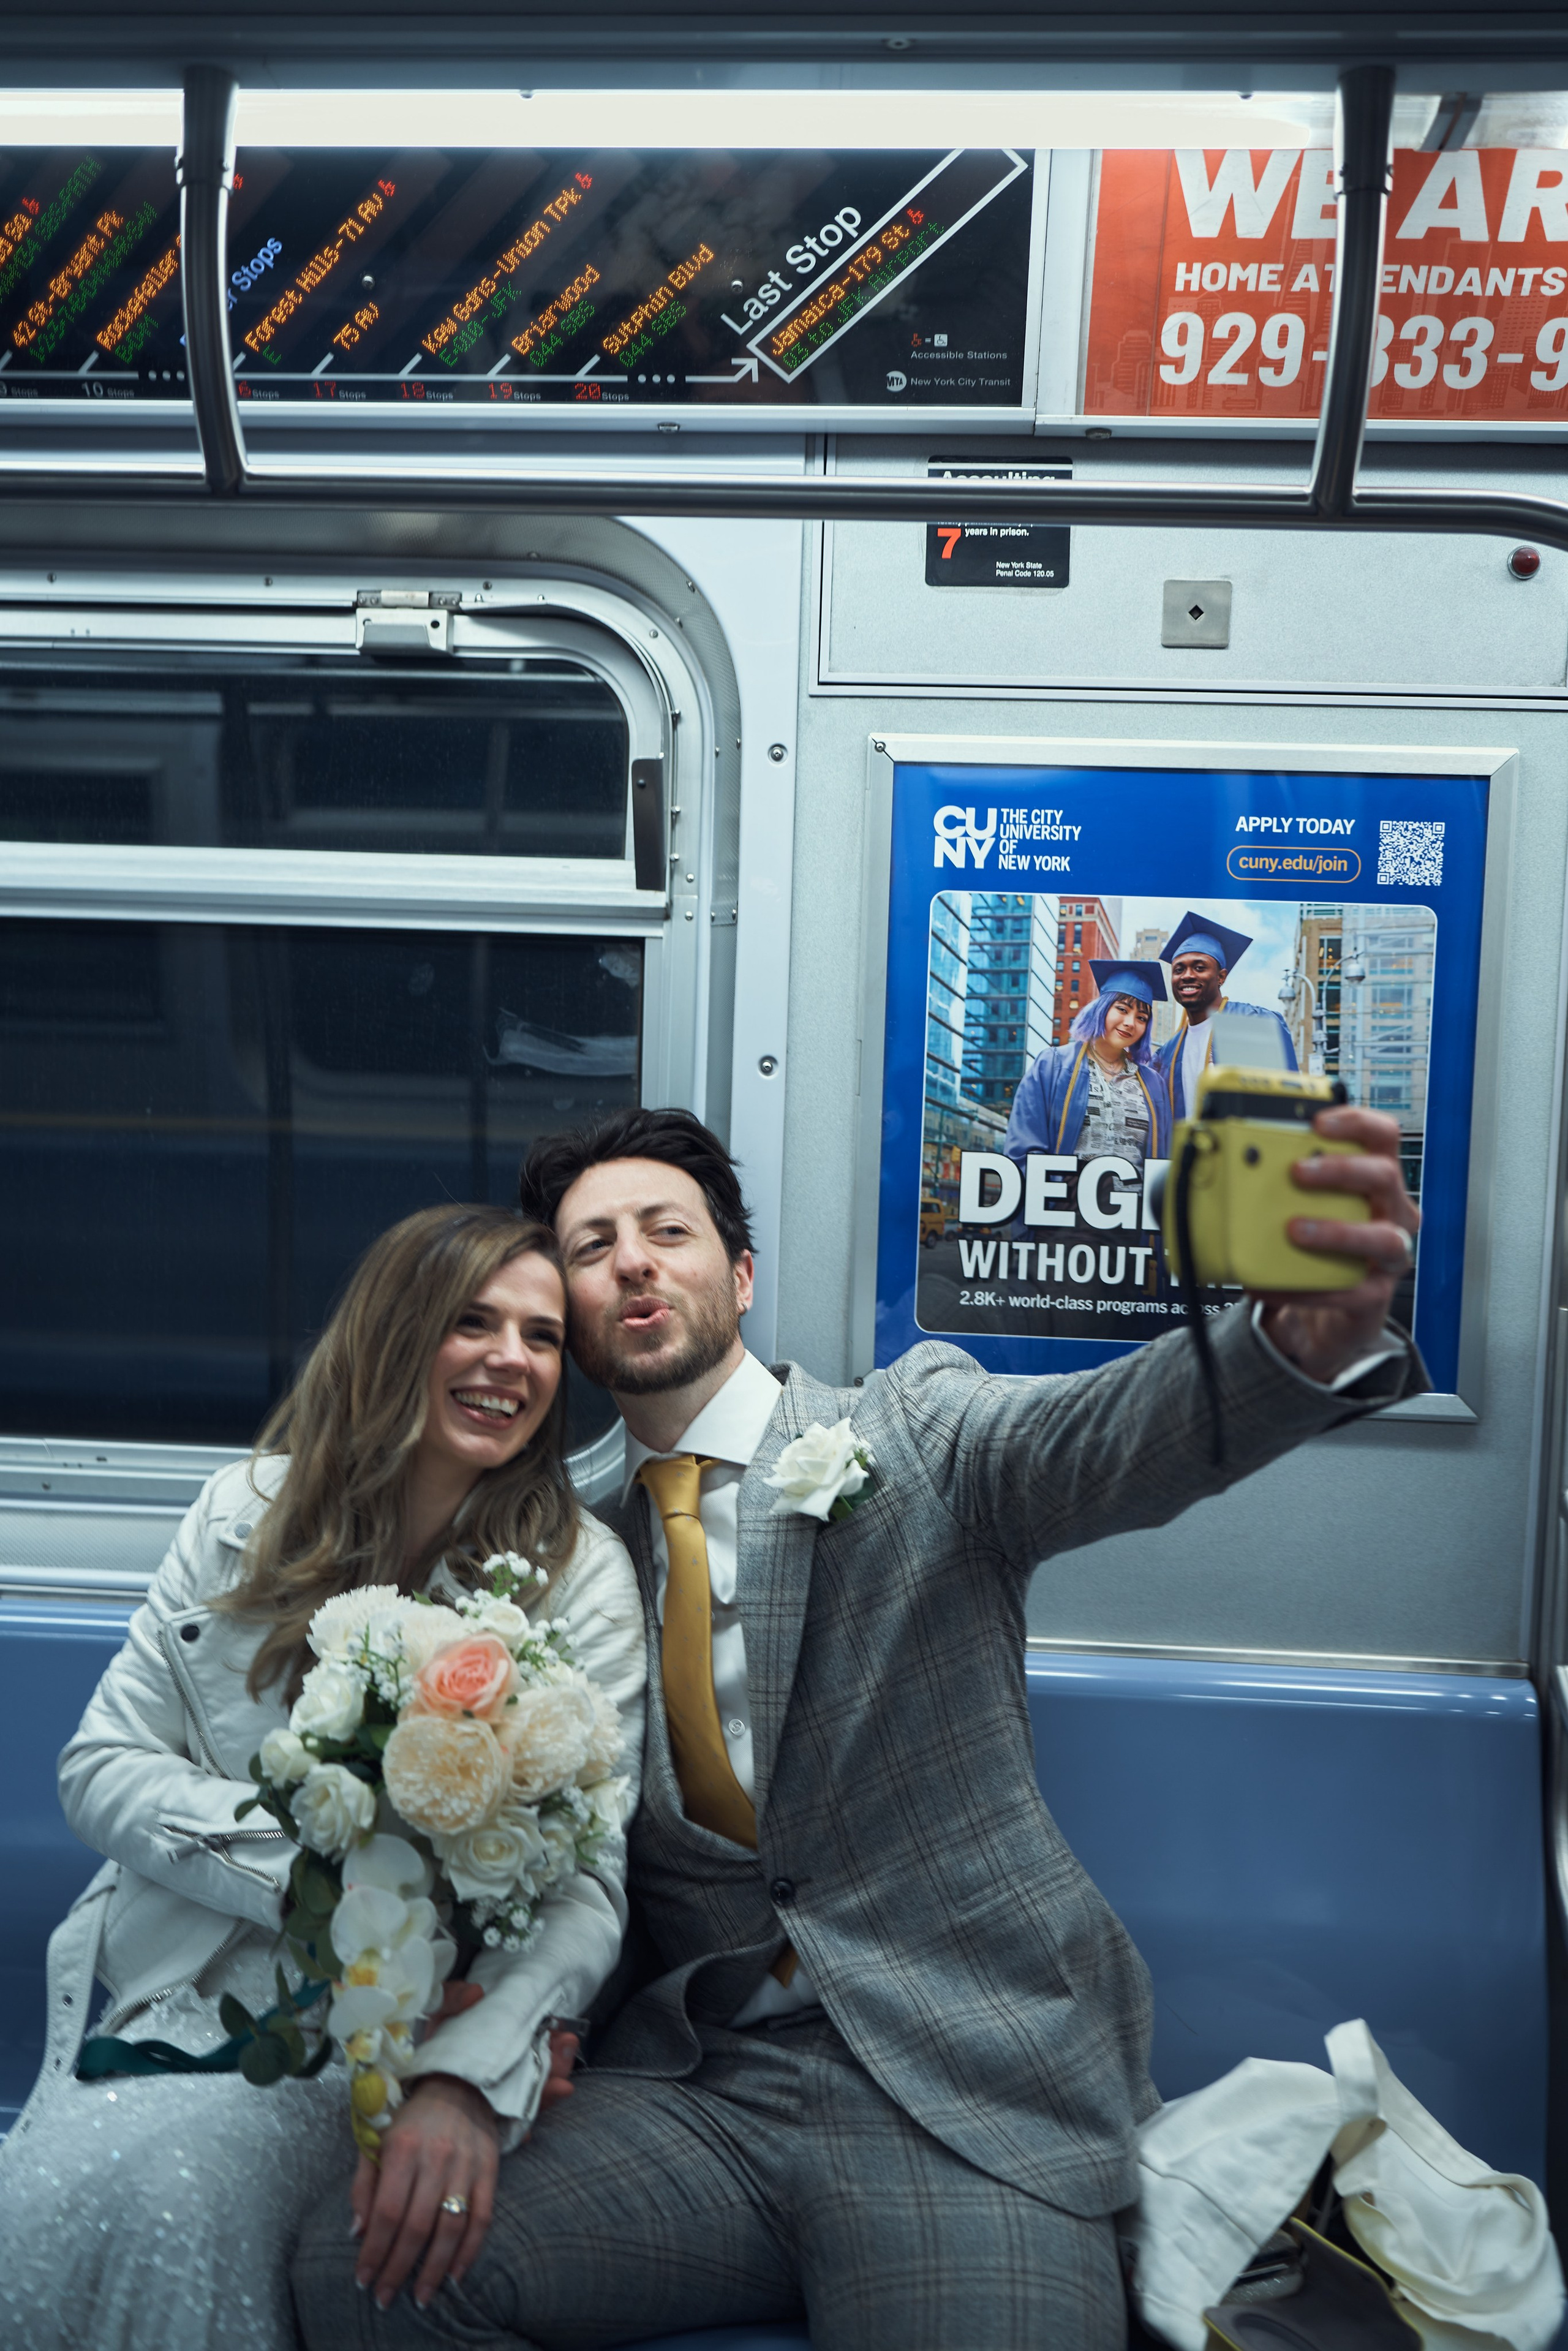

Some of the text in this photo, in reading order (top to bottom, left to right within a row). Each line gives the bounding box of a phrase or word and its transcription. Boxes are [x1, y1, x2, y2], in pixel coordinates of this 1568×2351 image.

[1174, 149, 1336, 240] WE
[232, 237, 283, 292] Stops
[245, 193, 383, 352] Forest Hills-71 Av
[422, 188, 582, 354] Kew Gdns-Union Tpk
[720, 206, 862, 335] Last Stop
[13, 211, 123, 348] 42 St-Bryant Pk
[772, 225, 910, 355] Jamaica-179 St
[1175, 263, 1567, 296] HOME AENDANTS
[96, 250, 179, 351] Rockefeller
[603, 244, 714, 354] Sutphin Blvd
[783, 222, 944, 369] Q3 to JFK Airport
[512, 265, 600, 355] Briarwood
[333, 303, 379, 350] 75 Av
[530, 301, 595, 366] Q44 SBS
[619, 301, 686, 366] Q44 SBS
[263, 345, 281, 364] E
[911, 351, 1008, 360] Accessible Stations
[81, 382, 135, 399] 10 Stops
[252, 389, 280, 401] Stops
[314, 381, 366, 401] 17 Stops
[426, 390, 454, 402] Stops
[489, 382, 541, 402] 19 Stops
[575, 383, 630, 402] 20 Stops
[934, 377, 955, 386] York
[958, 377, 976, 387] City
[979, 377, 1011, 386] Transit
[937, 528, 962, 559] 7
[965, 527, 1030, 538] years in prison.
[1001, 808, 1063, 825] THE CITY
[1235, 816, 1355, 834] APPLY TODAY
[1000, 823, 1082, 841] UNIVERSITY
[999, 839, 1018, 855] OF
[998, 855, 1070, 872] NEW YORK
[1238, 855, 1348, 874] cuny.edu/join
[959, 1239, 1153, 1286] WITHOUT
[959, 1290, 1221, 1316] 2.8K+ world-class programs acss
